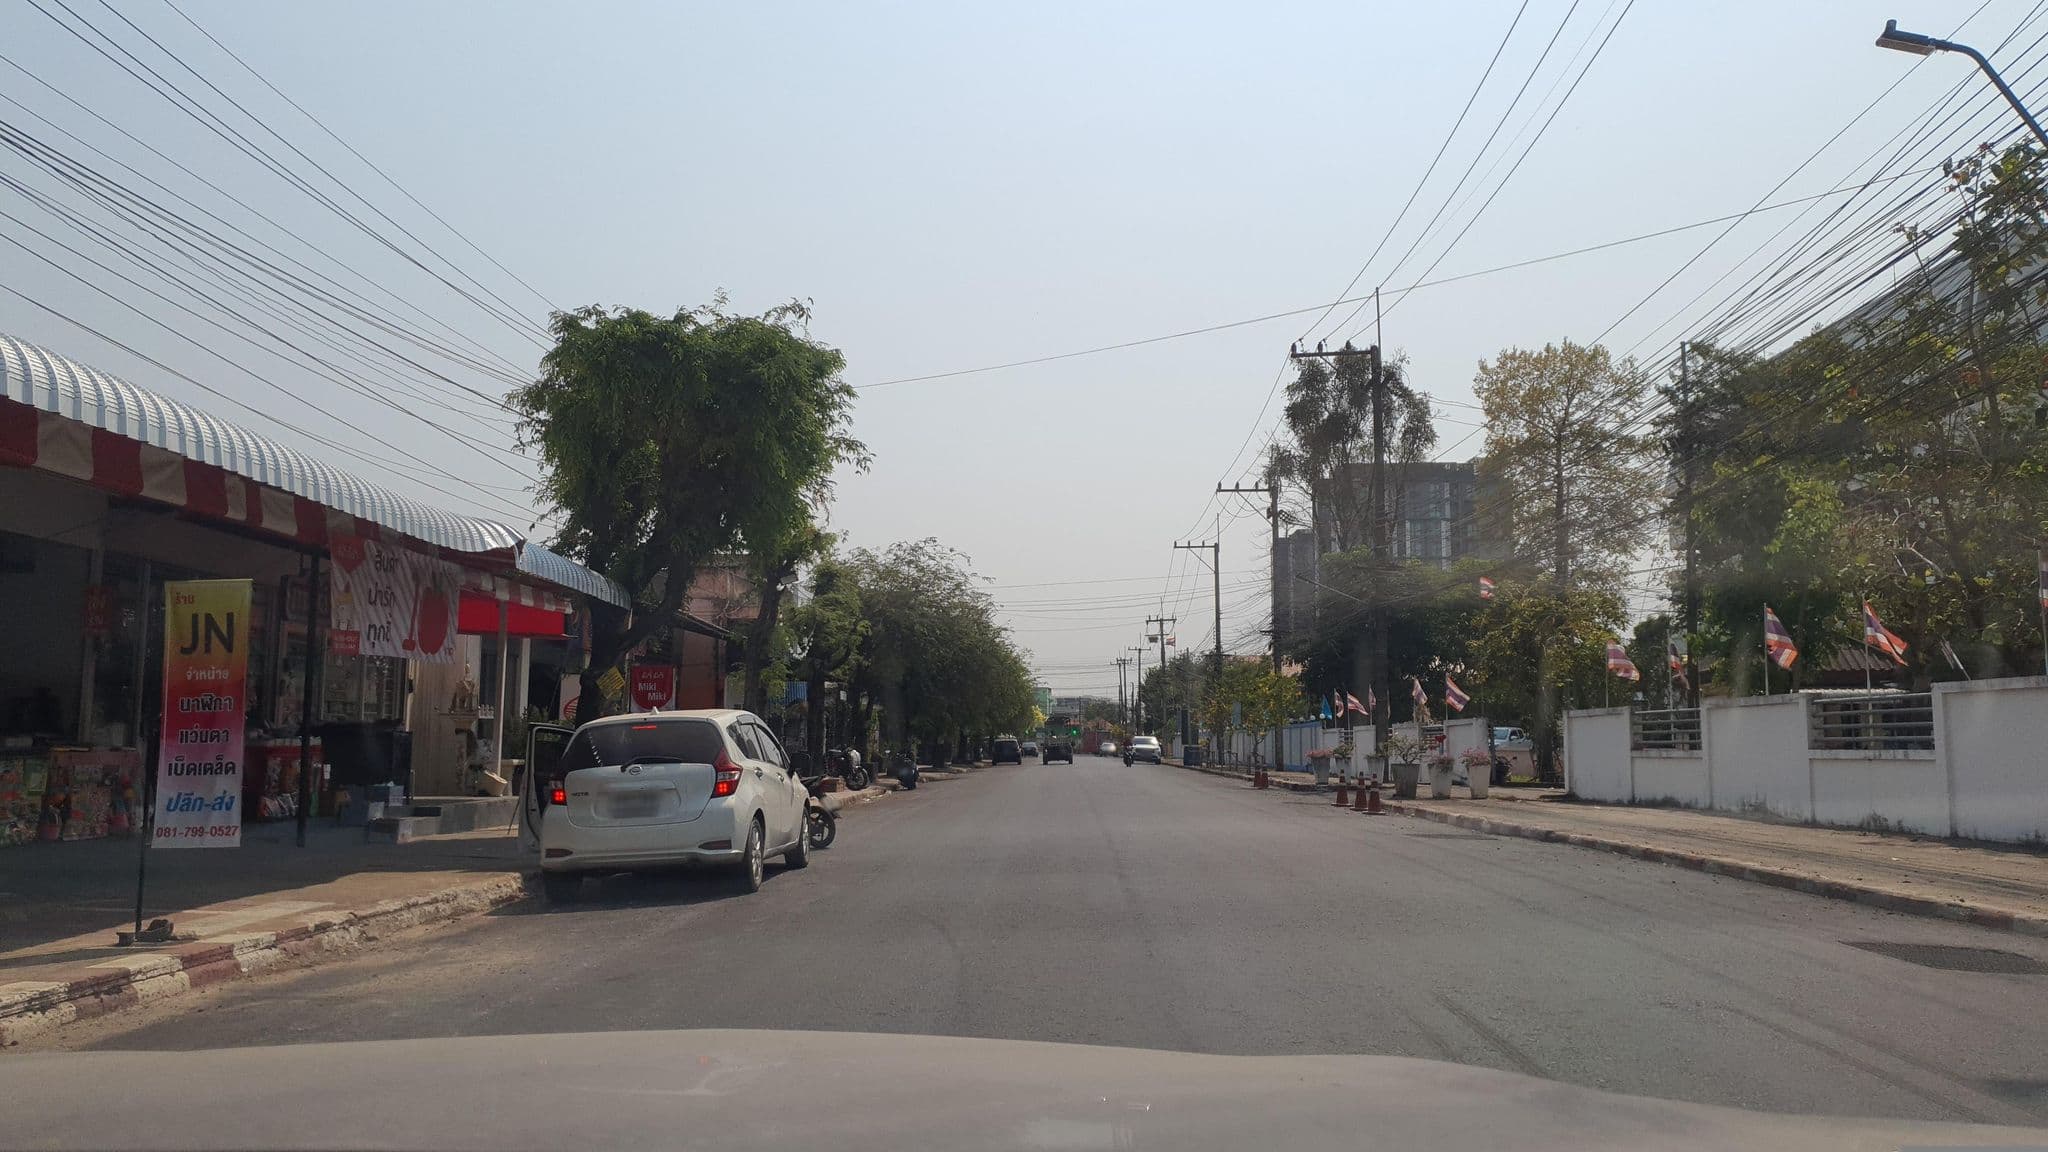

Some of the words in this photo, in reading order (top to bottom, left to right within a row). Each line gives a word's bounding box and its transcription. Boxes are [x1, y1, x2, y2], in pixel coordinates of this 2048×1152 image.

[175, 592, 195, 605] ร้าน
[368, 582, 396, 607] น่ารัก
[180, 612, 235, 655] JN
[186, 666, 229, 680] จำหน่าย
[638, 682, 657, 691] Miki
[179, 693, 234, 712] นาฬิกา
[178, 723, 230, 744] แว่นตา
[167, 754, 237, 777] เบ็ดเตล็ด
[165, 790, 236, 812] ปลีก-ส่ง
[156, 825, 239, 838] 081-799-0527
